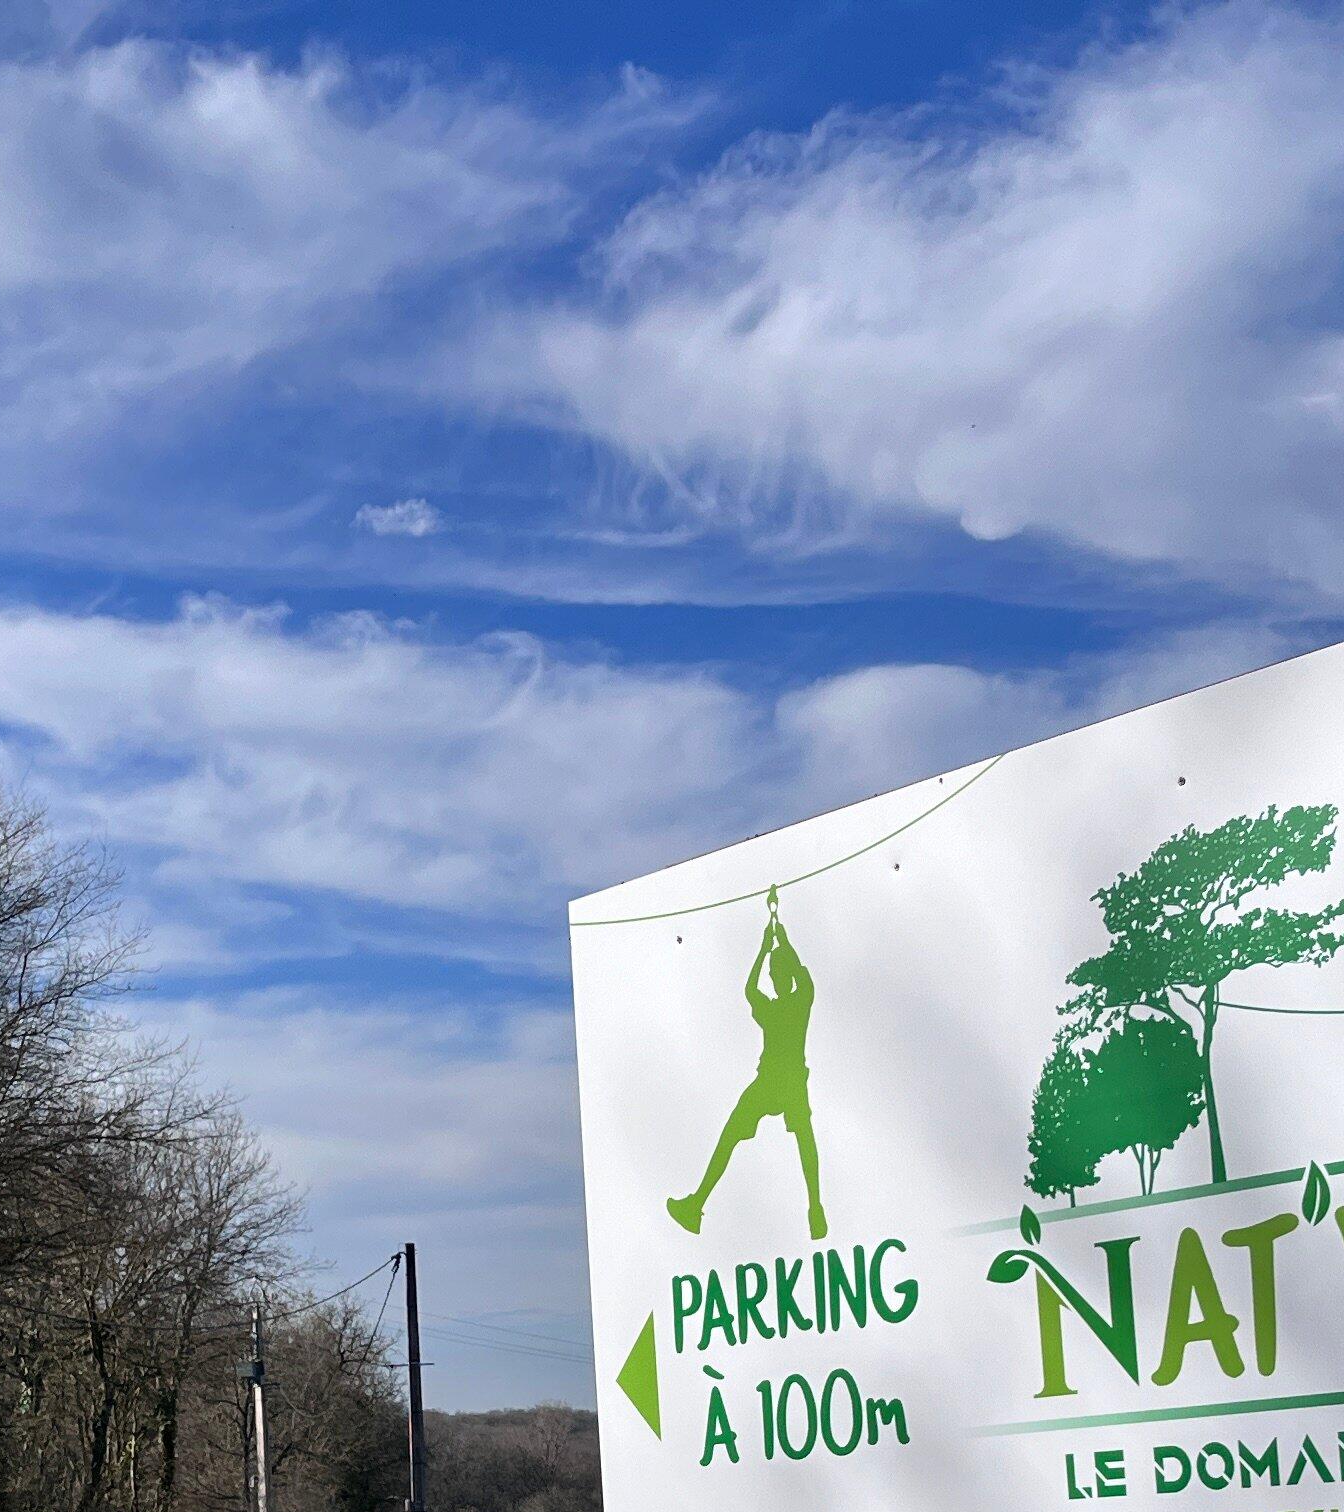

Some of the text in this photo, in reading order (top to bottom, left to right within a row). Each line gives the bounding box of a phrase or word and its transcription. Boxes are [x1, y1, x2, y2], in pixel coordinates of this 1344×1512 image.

[672, 1238, 919, 1353] PARKING
[699, 1365, 910, 1467] À 100m
[1065, 1449, 1128, 1500] LE
